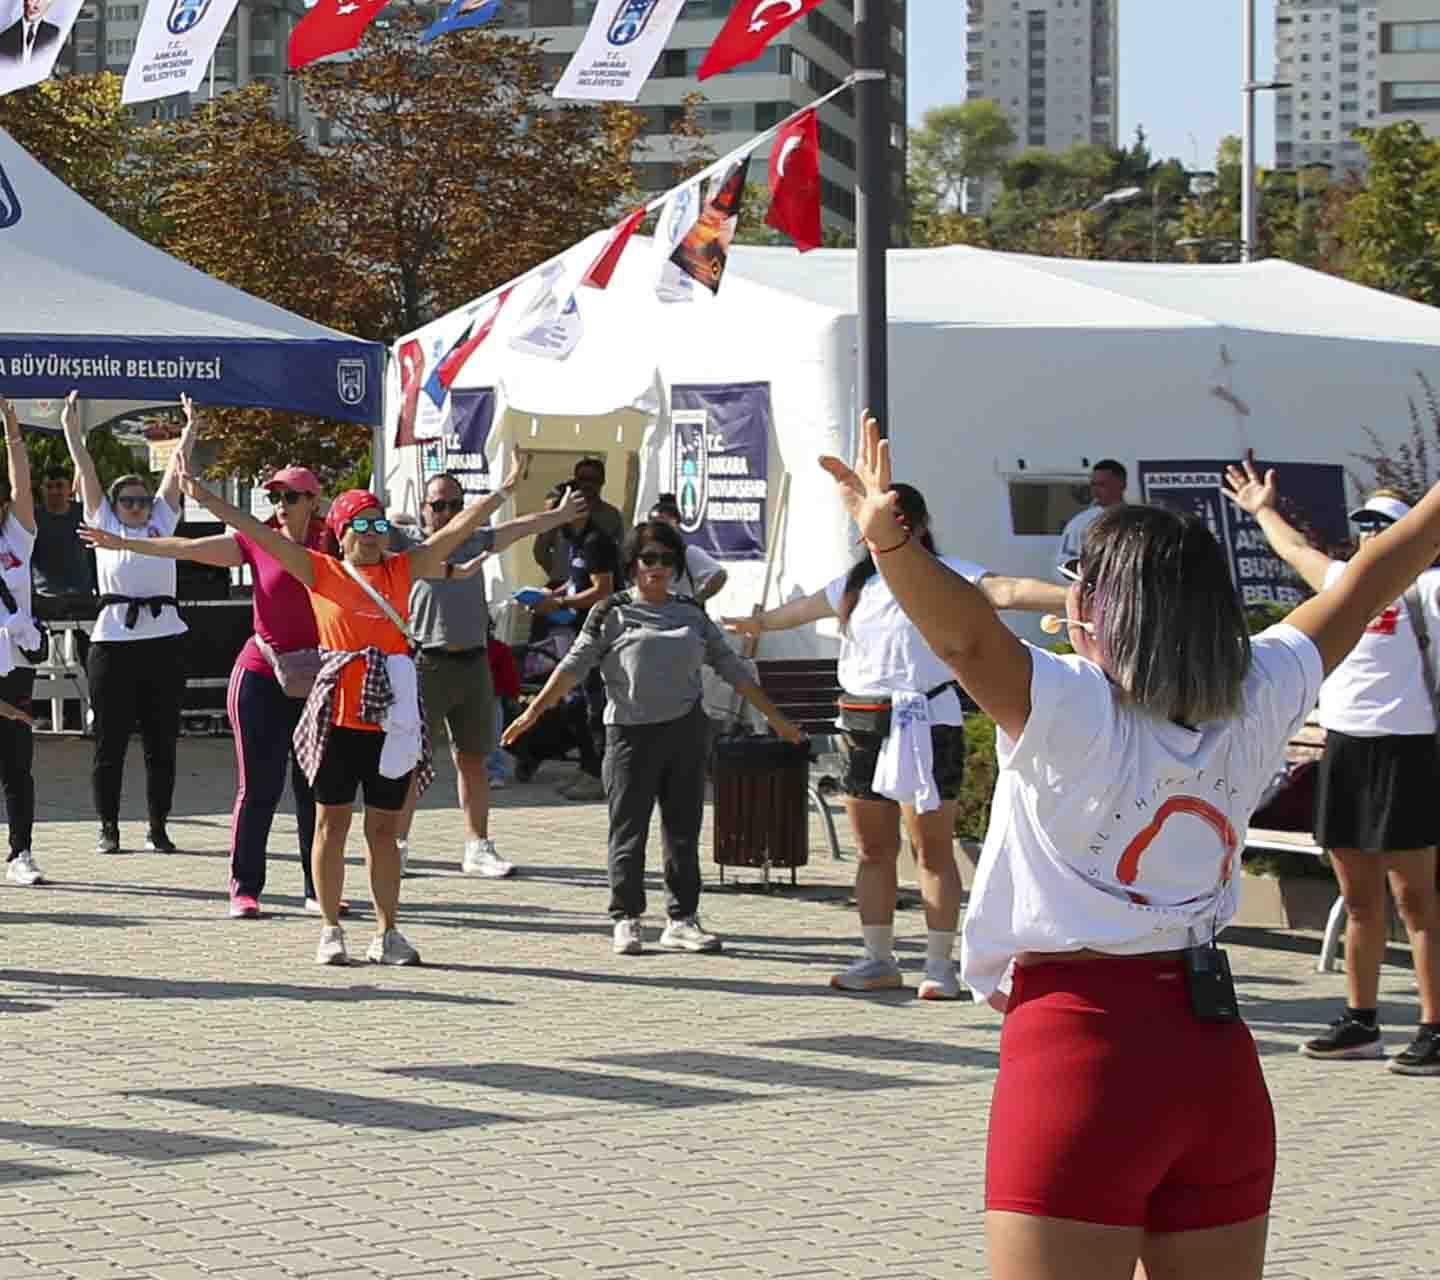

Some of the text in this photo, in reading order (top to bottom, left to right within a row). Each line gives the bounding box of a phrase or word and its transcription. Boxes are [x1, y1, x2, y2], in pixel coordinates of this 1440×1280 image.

[11, 353, 122, 380] BÜYÜKŞEHİR
[126, 355, 222, 380] BELEDİYESİ
[1146, 473, 1220, 486] ANKARA
